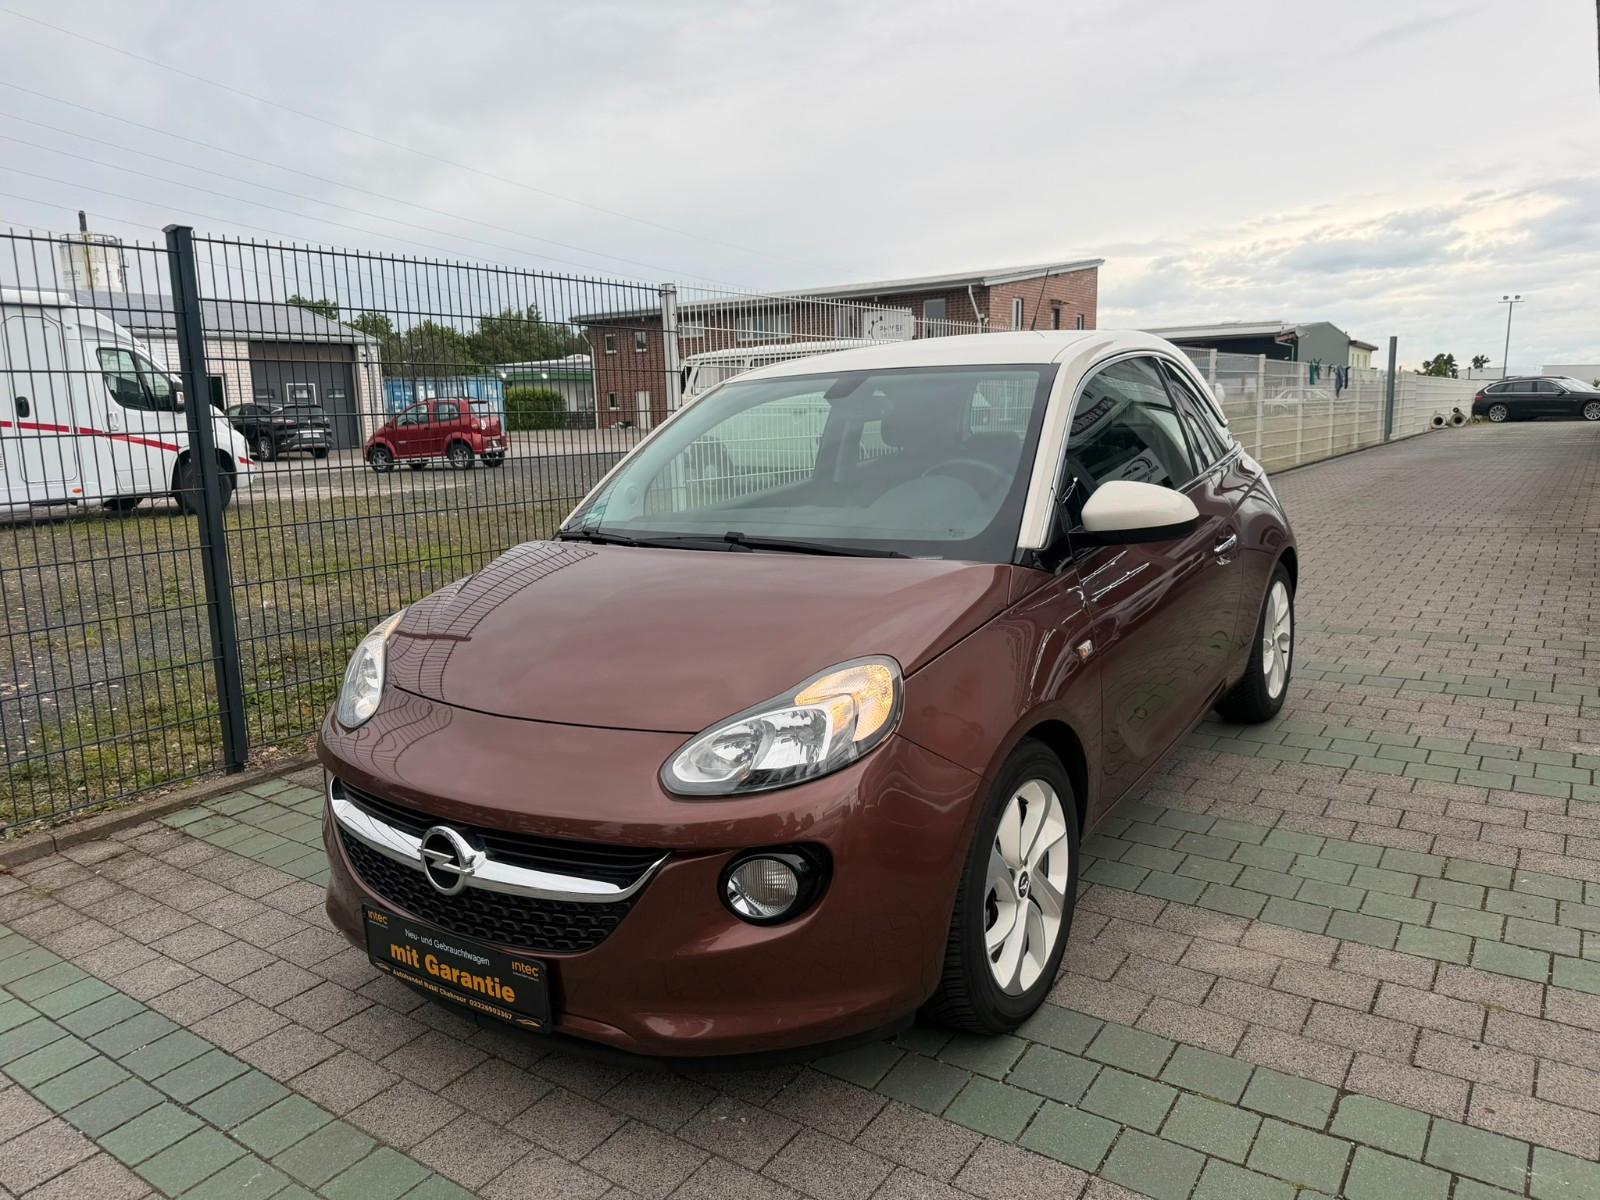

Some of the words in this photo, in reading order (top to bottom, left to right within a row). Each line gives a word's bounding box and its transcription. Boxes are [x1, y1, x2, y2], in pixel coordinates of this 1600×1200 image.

[404, 929, 420, 941] Neu-
[420, 936, 434, 946] und
[433, 939, 490, 966] Gebrauchtwagen
[390, 942, 420, 968] mit
[424, 953, 515, 1003] Garantie
[392, 970, 423, 986] Autohandel
